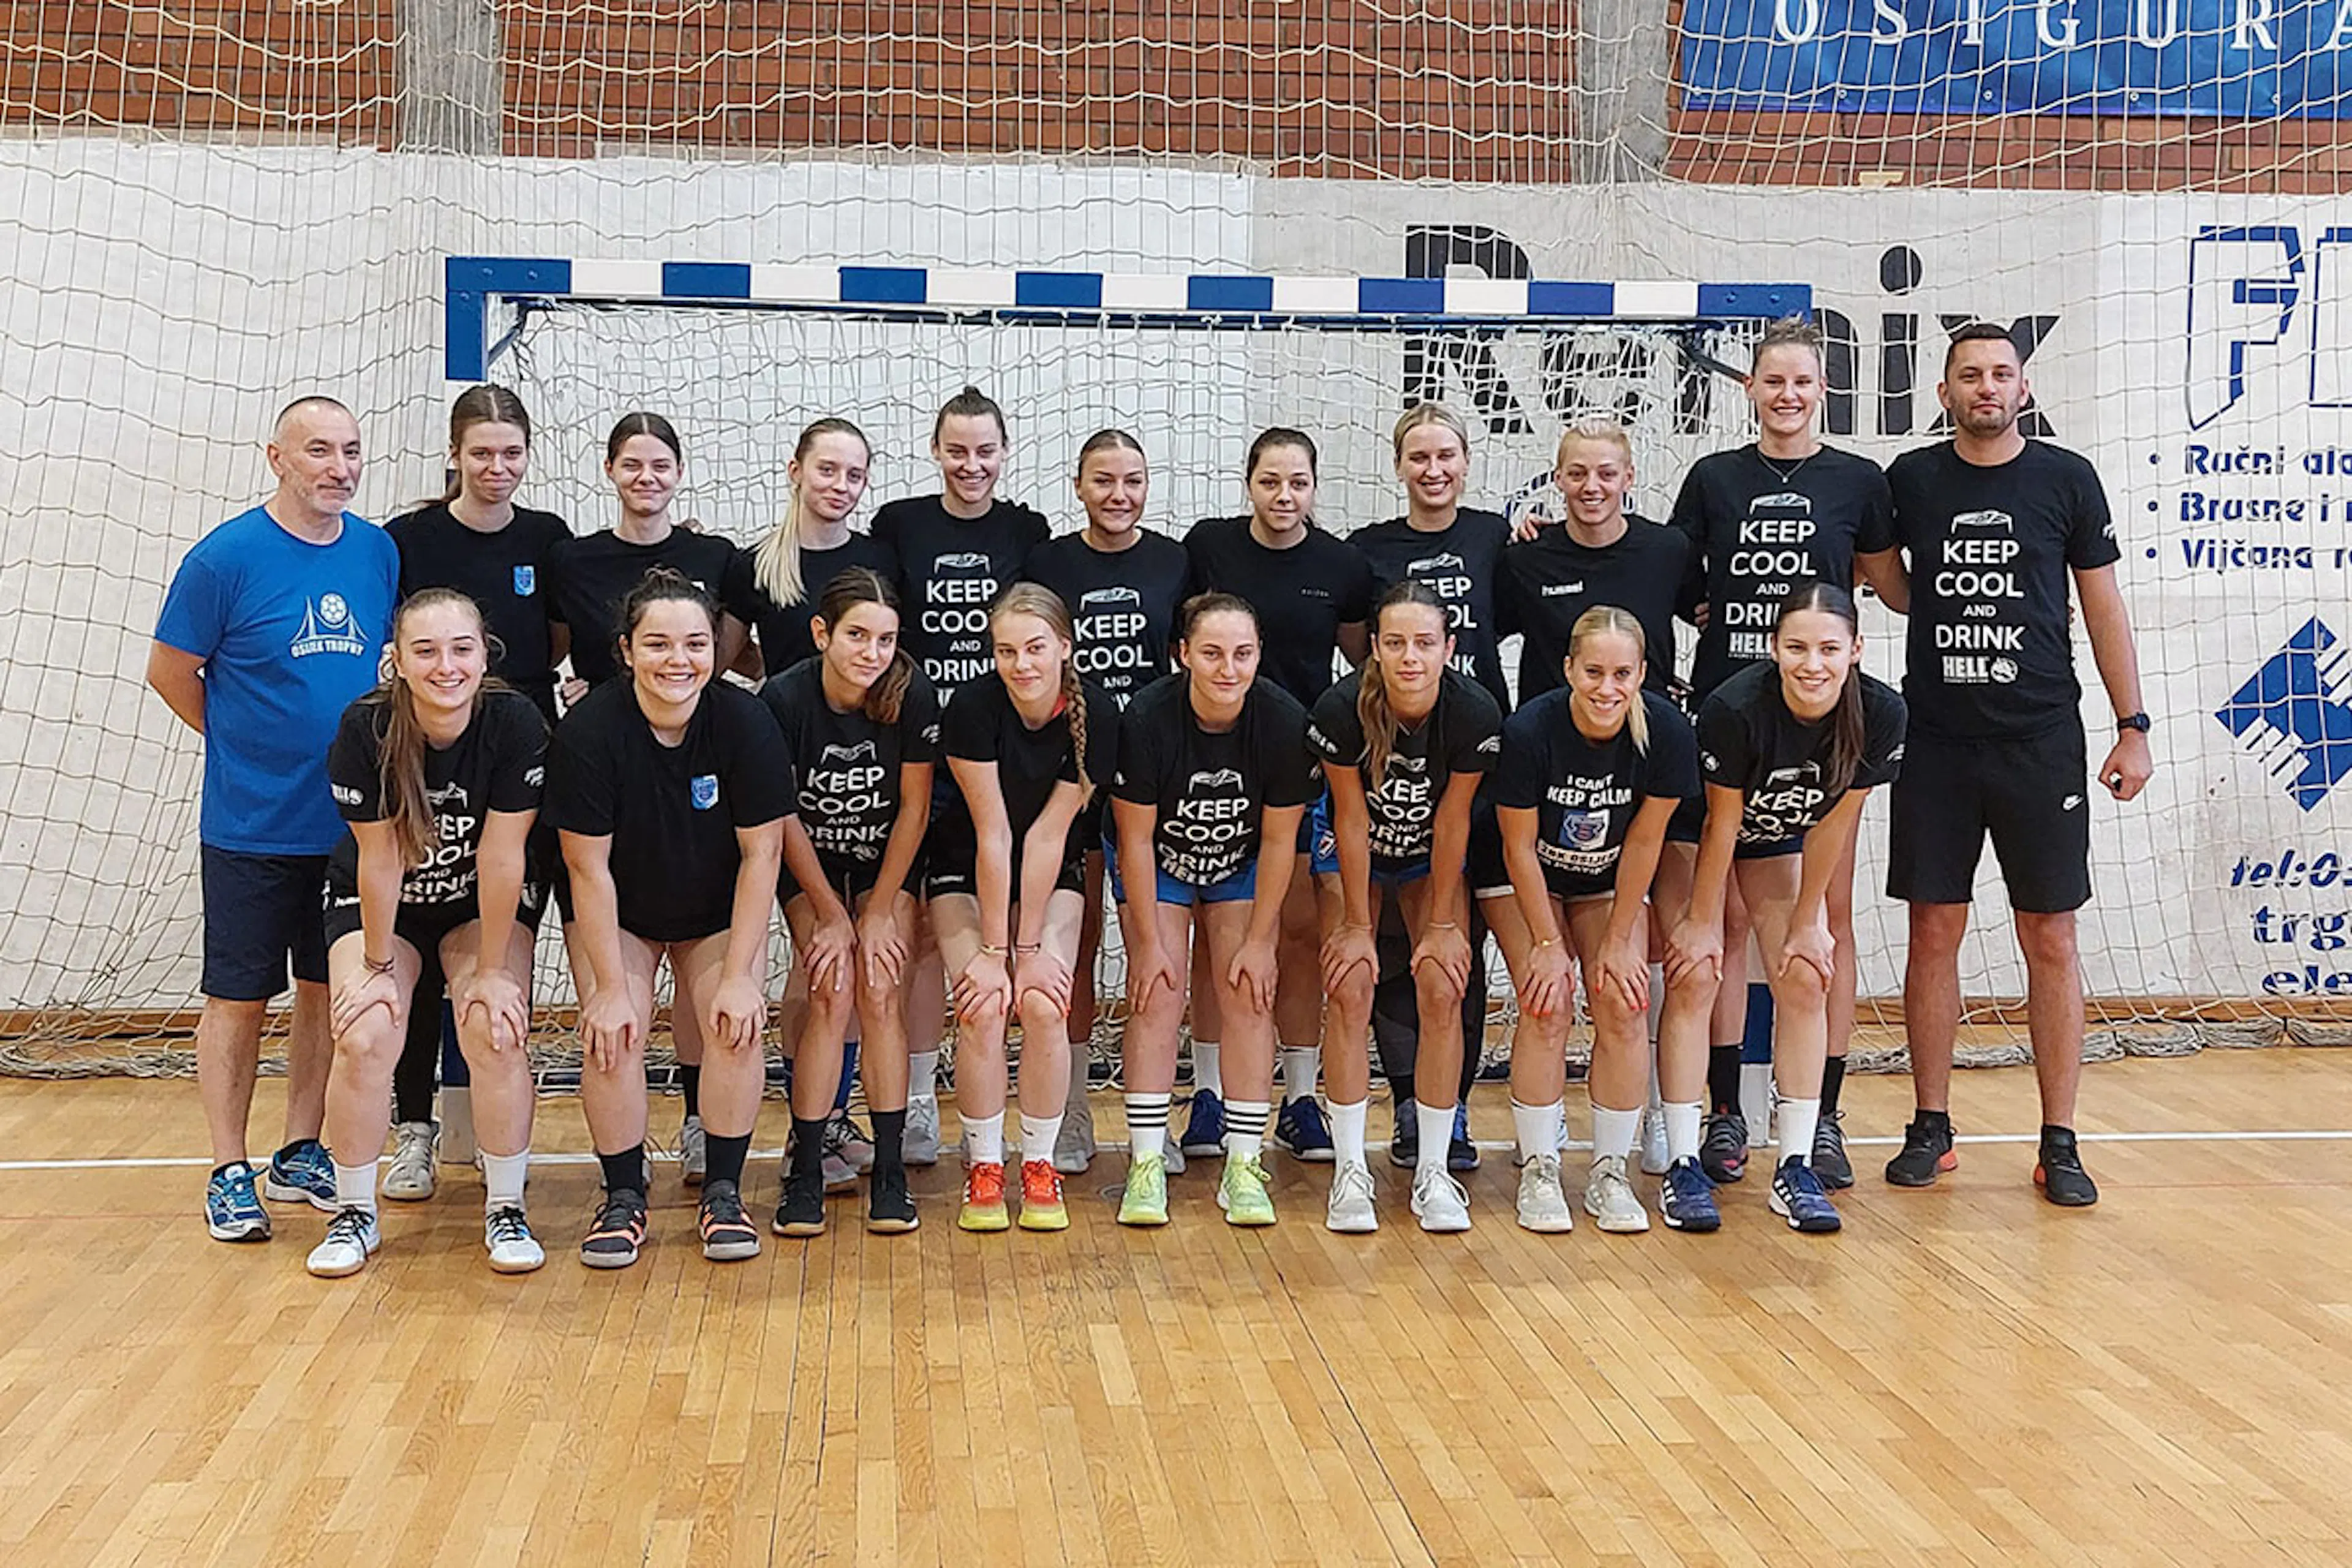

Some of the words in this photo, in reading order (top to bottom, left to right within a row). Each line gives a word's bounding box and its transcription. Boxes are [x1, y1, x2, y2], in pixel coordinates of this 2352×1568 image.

[2185, 445, 2284, 475] Ručni
[2180, 492, 2305, 521] Brusne
[1738, 520, 1817, 545] KEEP
[1730, 551, 1817, 576] COOL
[1942, 540, 2021, 564] KEEP
[2181, 539, 2312, 576] Vijčana
[925, 579, 999, 603] KEEP
[1755, 582, 1791, 595] AND
[1935, 571, 2024, 598] COOL
[921, 608, 993, 633] COO
[1725, 601, 1781, 627] DRI
[1962, 604, 1997, 617] AND
[1073, 612, 1147, 642] KEEP
[1935, 624, 2026, 651] DRINK
[950, 640, 981, 652] AND
[1072, 644, 1154, 673] COOL
[924, 657, 997, 682] DRIN
[1942, 655, 1989, 677] HELL
[1104, 676, 1133, 689] AND
[807, 766, 886, 793] KEEP
[1566, 774, 1574, 785] I
[797, 791, 891, 814] COOL
[1177, 797, 1250, 822] KEEP
[1547, 785, 1586, 807] KEEP
[1588, 786, 1632, 809] CALM
[1749, 785, 1825, 811] KEEP
[804, 821, 889, 842] RINK
[826, 815, 861, 826] AND
[1163, 820, 1254, 842] COOL
[1190, 843, 1224, 854] AND
